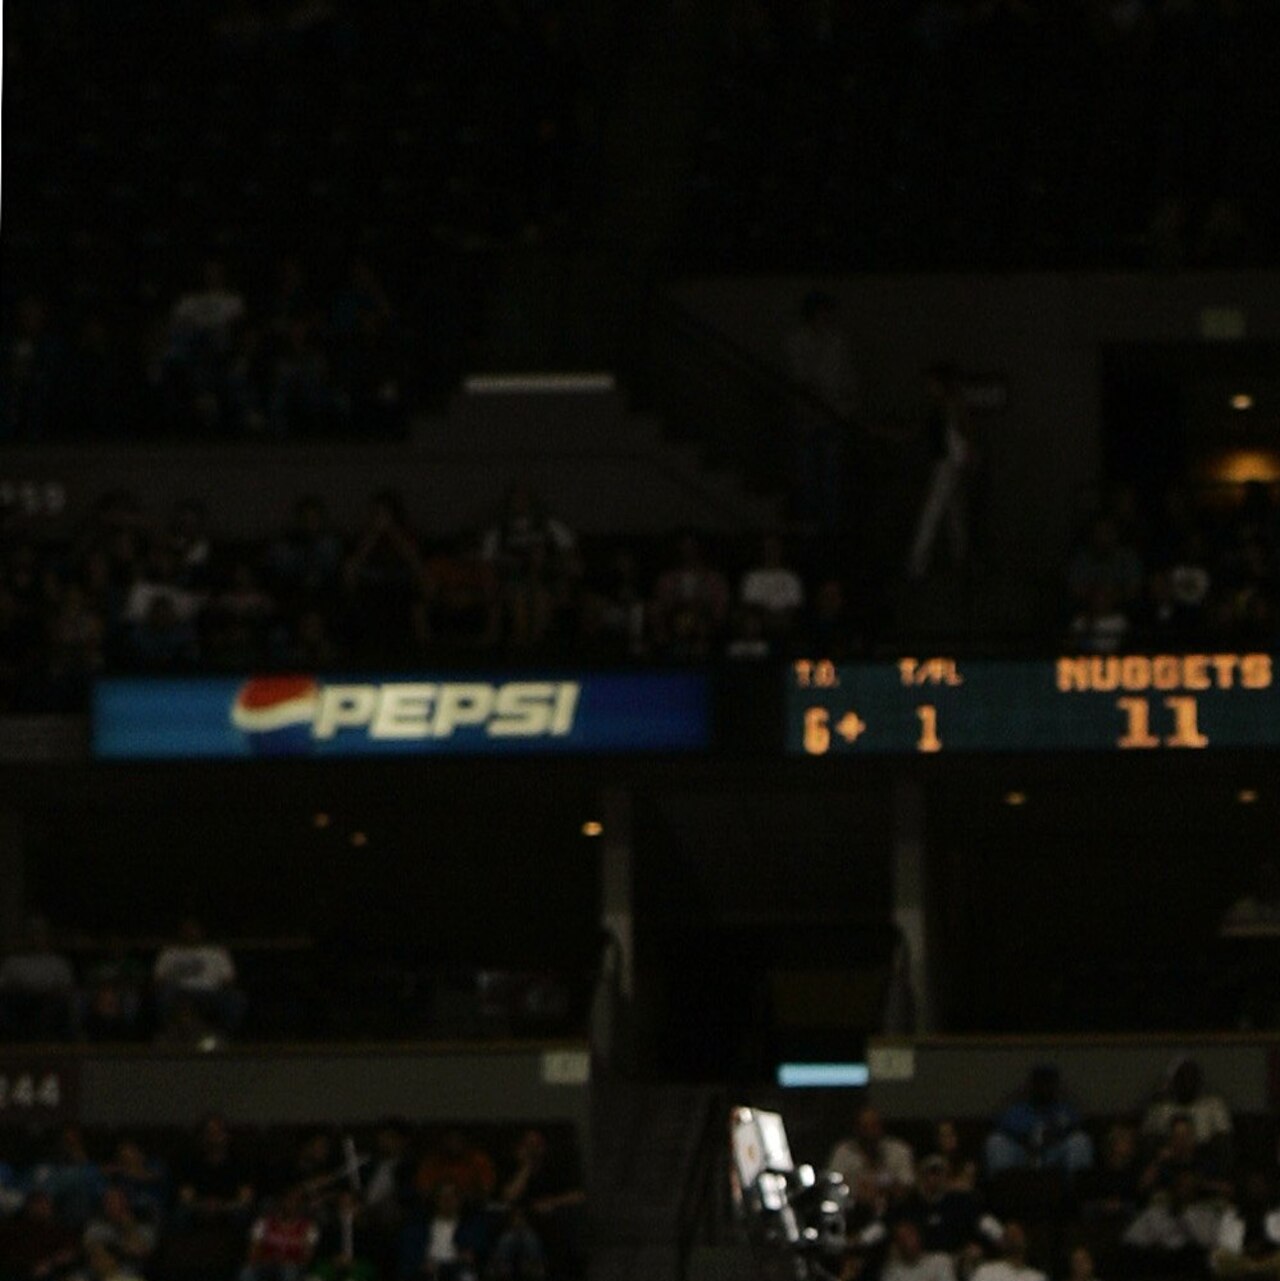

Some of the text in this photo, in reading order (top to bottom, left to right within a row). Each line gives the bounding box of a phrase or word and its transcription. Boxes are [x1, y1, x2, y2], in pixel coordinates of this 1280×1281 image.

[1055, 653, 1274, 692] NUGGETS
[311, 681, 581, 740] PEPSI
[917, 704, 942, 752] 1
[1115, 696, 1210, 749] 11
